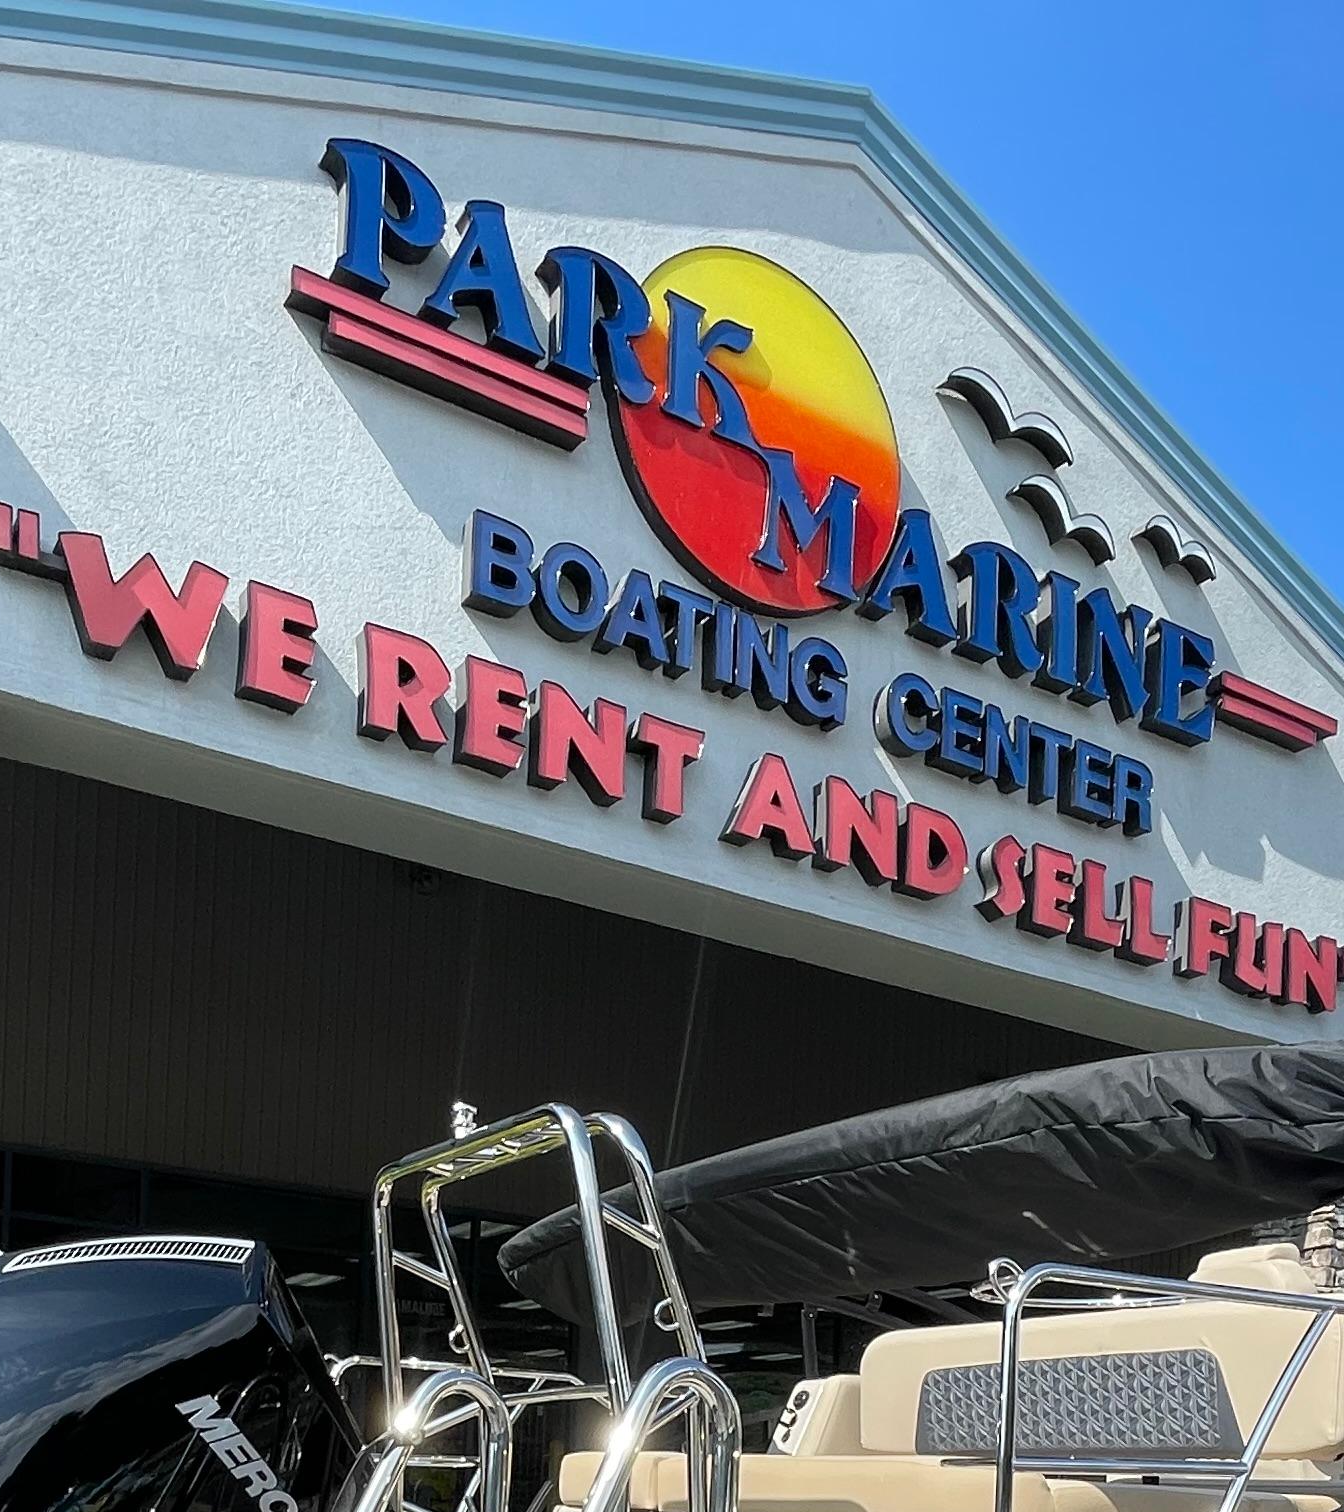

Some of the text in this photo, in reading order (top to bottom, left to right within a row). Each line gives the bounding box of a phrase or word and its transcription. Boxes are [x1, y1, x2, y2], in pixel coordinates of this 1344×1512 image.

[320, 138, 760, 450] PARK
[463, 509, 1153, 836] BOATING CENTER
[751, 446, 1215, 746] MARINE
[357, 622, 704, 825] RENT
[718, 753, 968, 899] AND
[975, 835, 1171, 967] SELL
